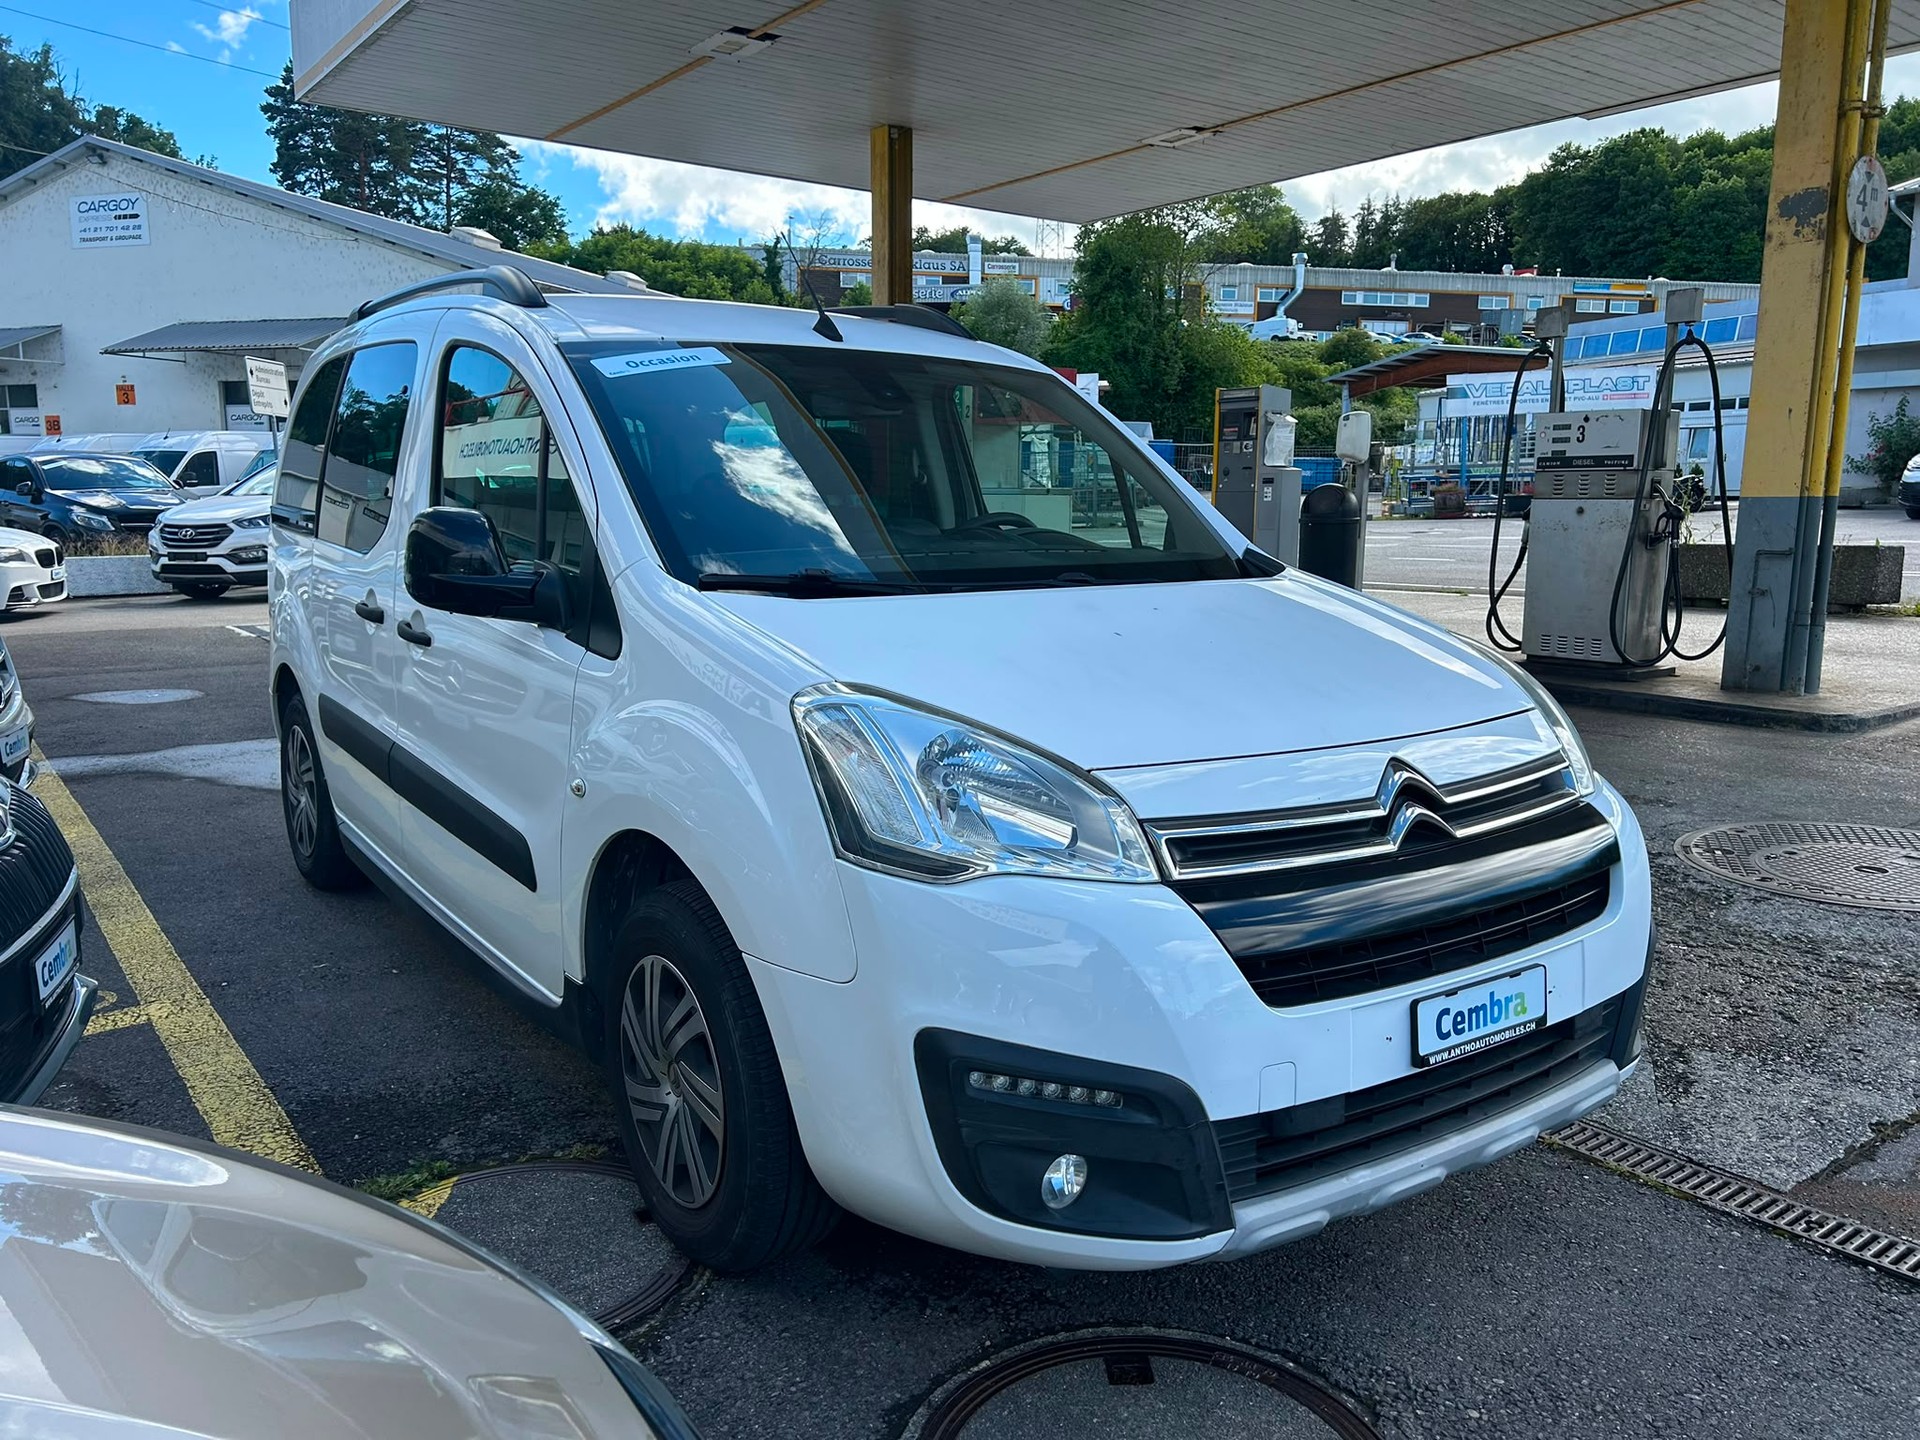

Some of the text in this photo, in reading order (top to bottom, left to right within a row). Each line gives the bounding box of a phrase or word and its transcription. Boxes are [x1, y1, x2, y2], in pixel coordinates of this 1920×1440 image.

[77, 197, 140, 213] CARGOY
[1856, 184, 1879, 212] 4 m
[79, 235, 108, 243] TRANSPORT
[949, 260, 967, 272] SA
[625, 354, 702, 369] Occasion
[1466, 376, 1650, 398] VERALPLAST
[122, 392, 130, 404] 3
[46, 420, 60, 431] 3B
[1576, 425, 1586, 443] 3
[41, 939, 73, 988] Cembra
[1435, 990, 1528, 1041] Cembra
[1428, 1021, 1537, 1065] WWW.ANTHOAUTOMOBILES.CH
